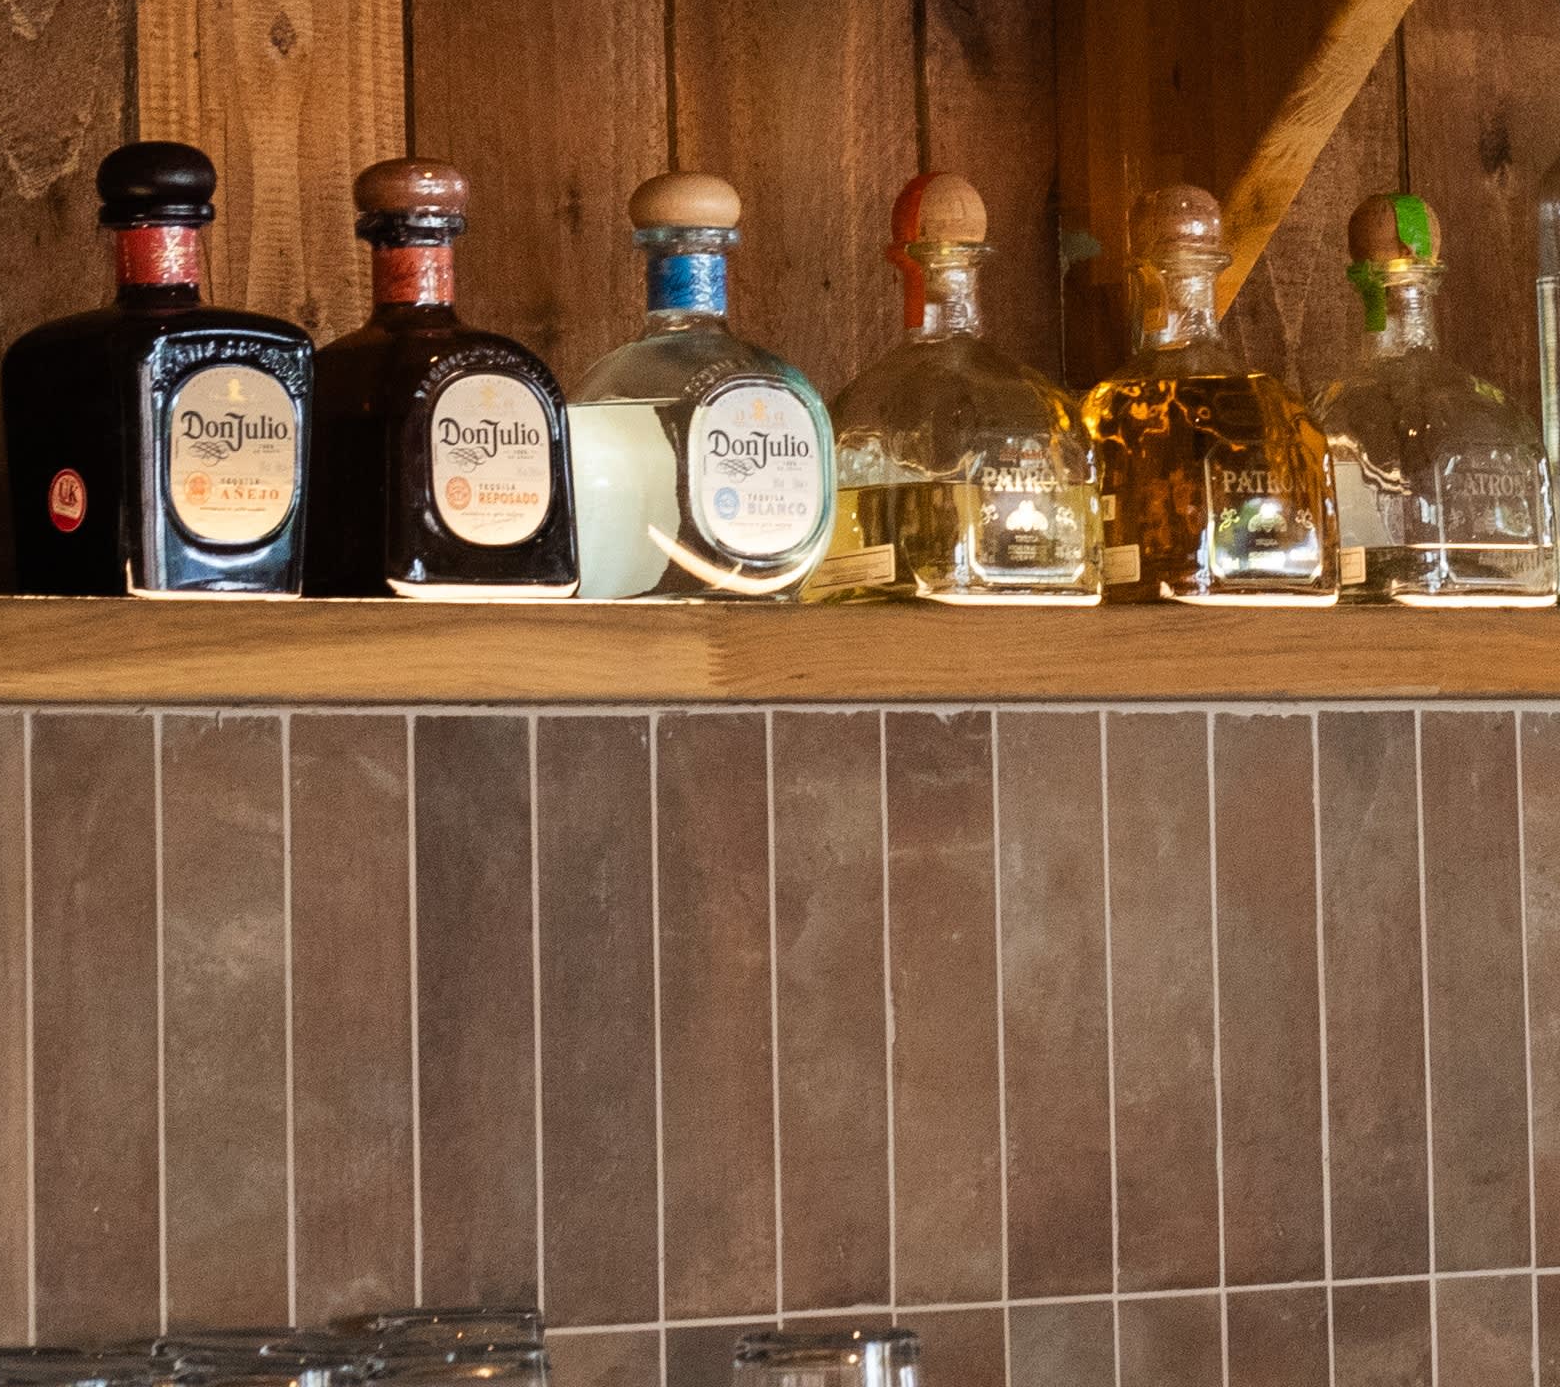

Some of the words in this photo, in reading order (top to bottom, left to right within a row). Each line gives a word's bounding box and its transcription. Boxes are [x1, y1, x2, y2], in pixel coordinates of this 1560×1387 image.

[220, 486, 281, 500] AÑEJO
[479, 493, 539, 506] REPOSADO
[747, 503, 808, 517] BLANCO
